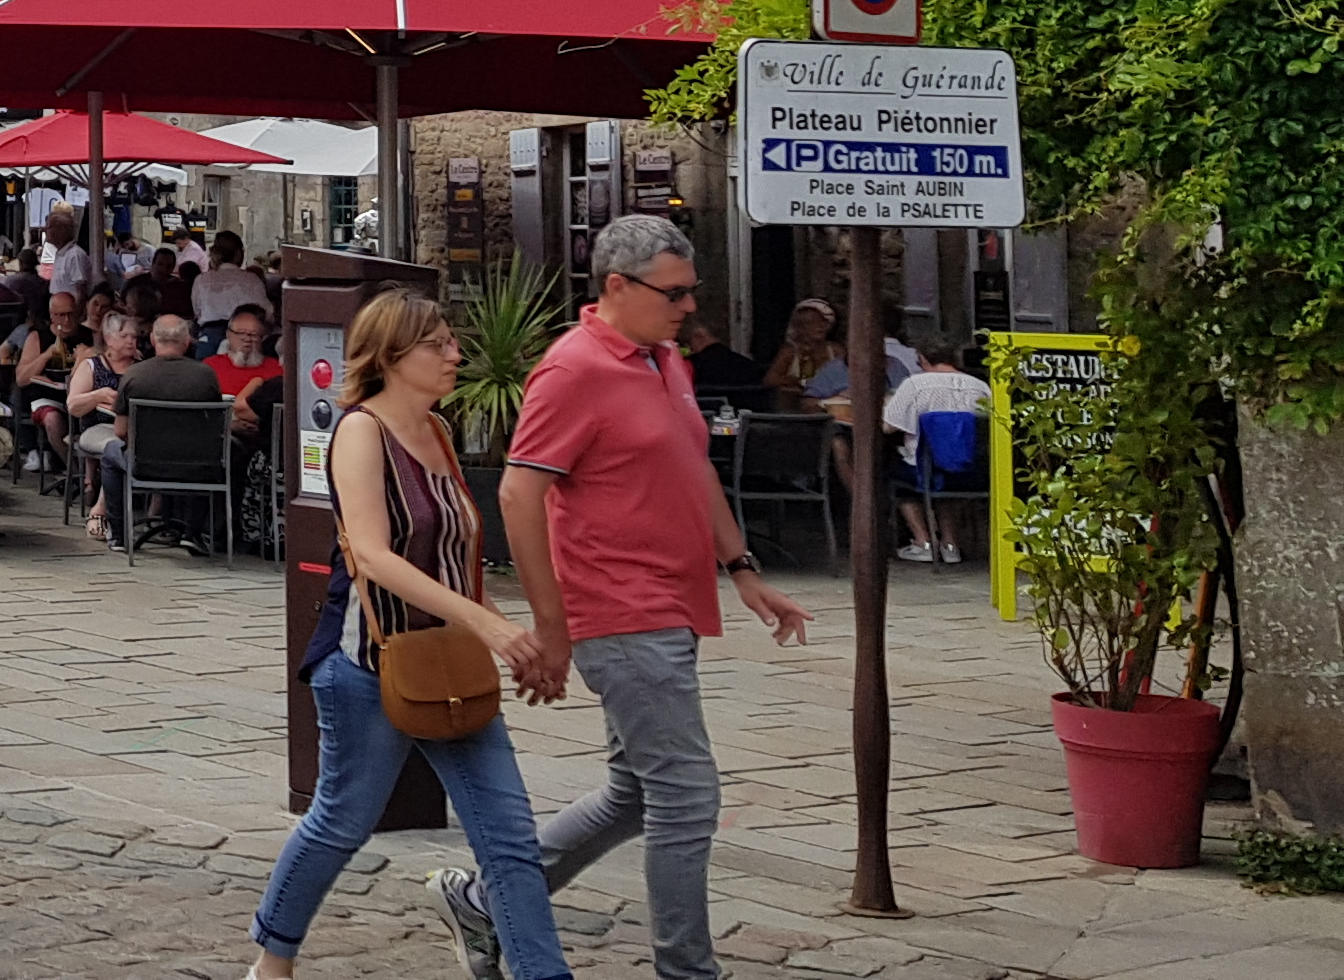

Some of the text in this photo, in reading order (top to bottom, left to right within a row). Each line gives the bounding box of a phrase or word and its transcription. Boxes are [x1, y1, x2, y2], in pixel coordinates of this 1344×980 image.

[783, 54, 1006, 99] Ville de Guérande
[771, 106, 998, 135] Plateau Piétonnier
[828, 143, 919, 173] Gratuit
[931, 147, 969, 174] 150
[973, 153, 1003, 175] m.
[809, 179, 964, 197] Place Saint AUBIN
[790, 200, 984, 219] Place de la PSALETTE
